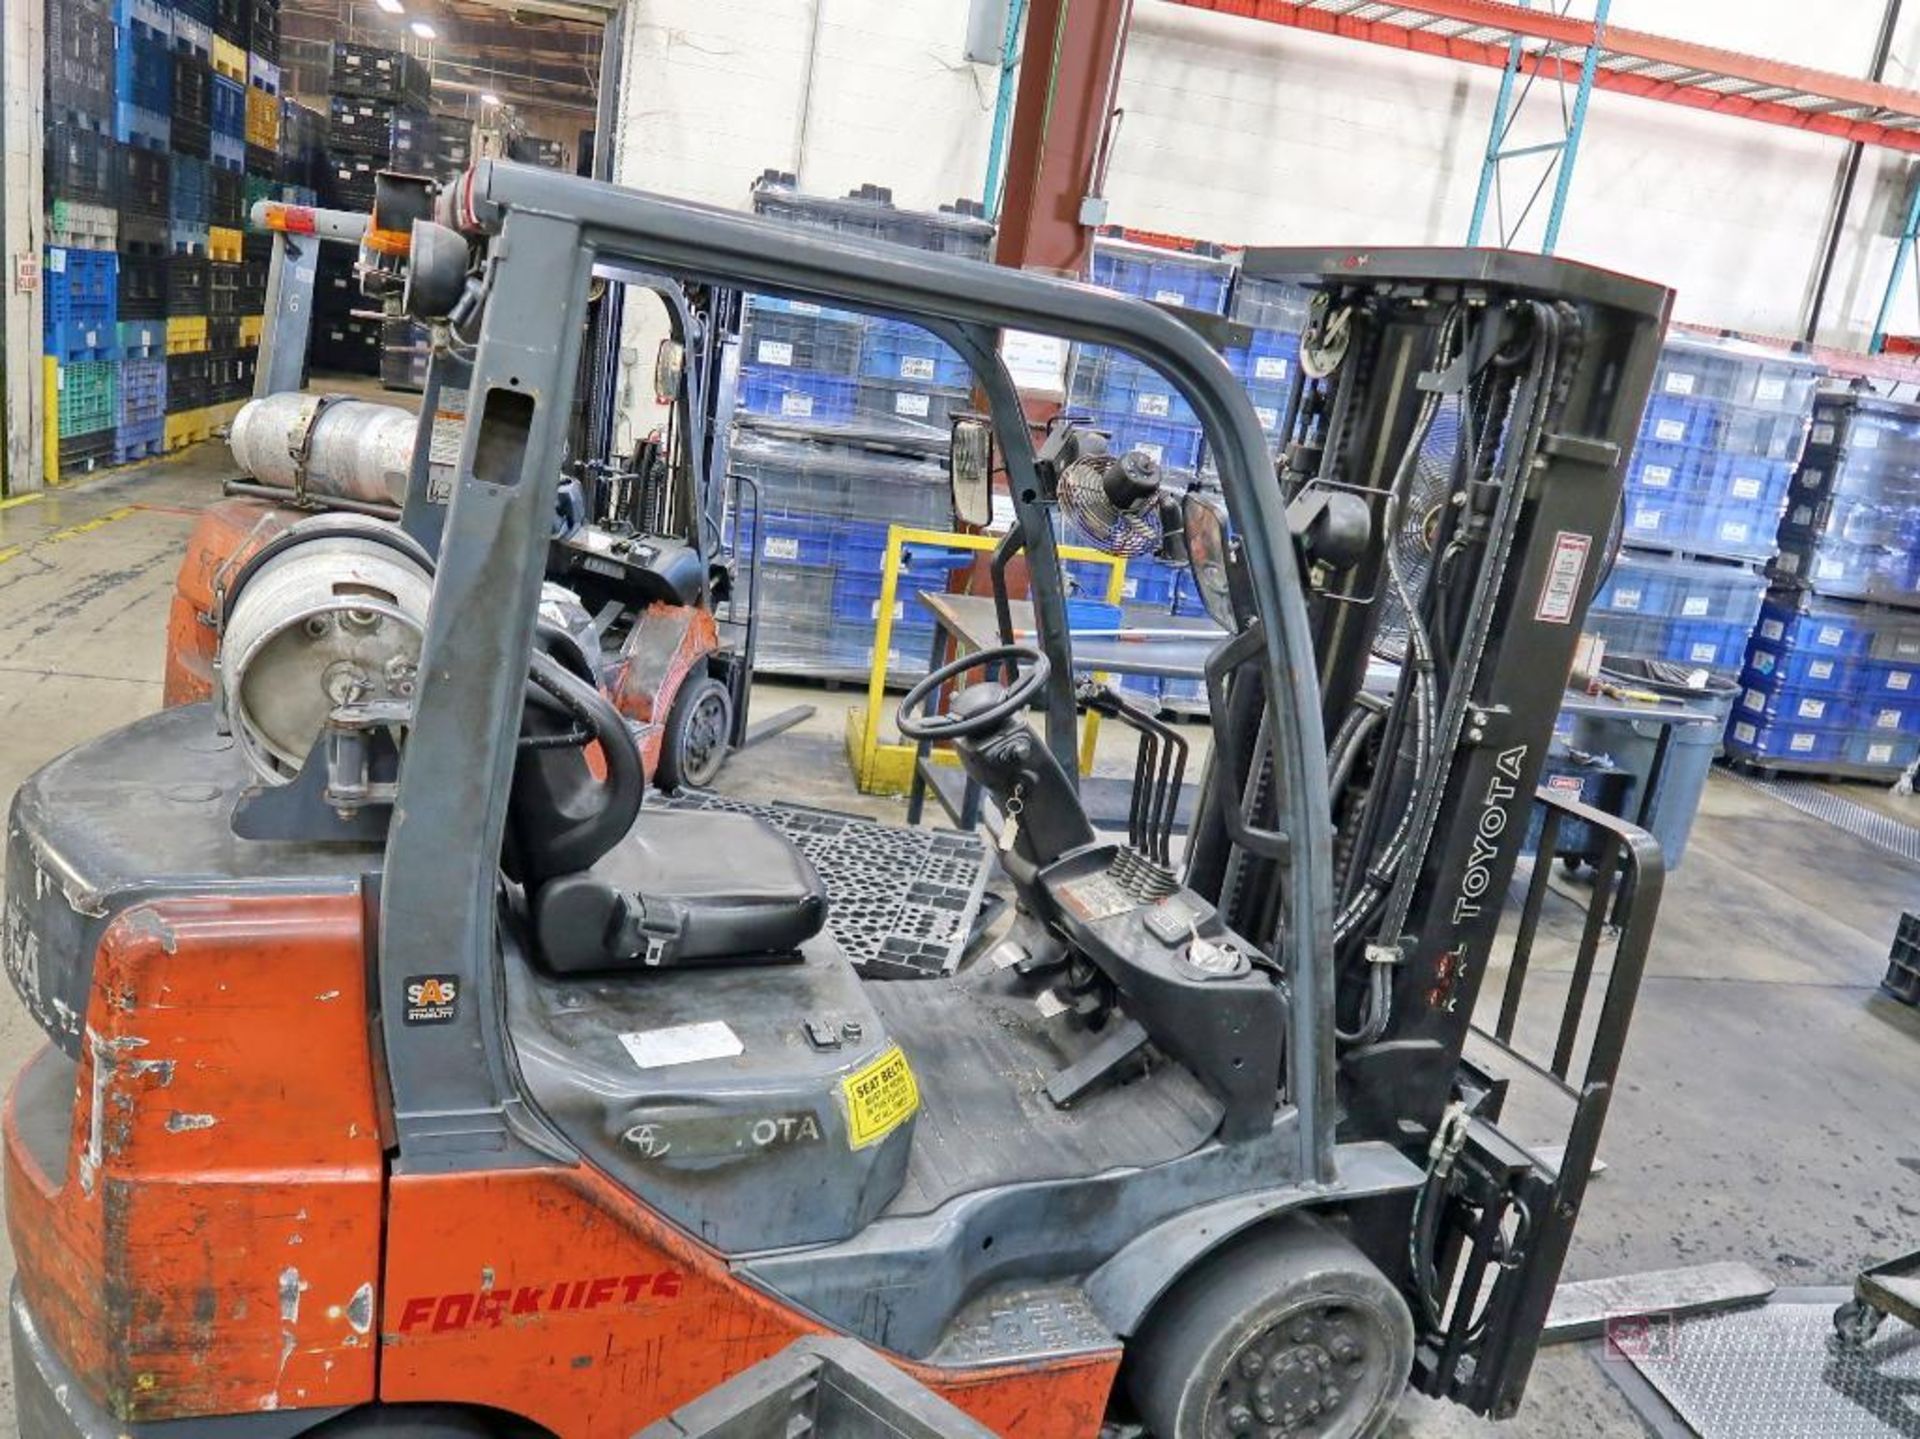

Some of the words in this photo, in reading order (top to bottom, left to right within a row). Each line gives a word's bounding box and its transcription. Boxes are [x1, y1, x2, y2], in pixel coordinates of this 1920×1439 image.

[288, 293, 300, 312] 6
[1453, 745, 1528, 924] TOYOTA
[407, 979, 456, 1006] SAS
[856, 1075, 879, 1099] SEAT
